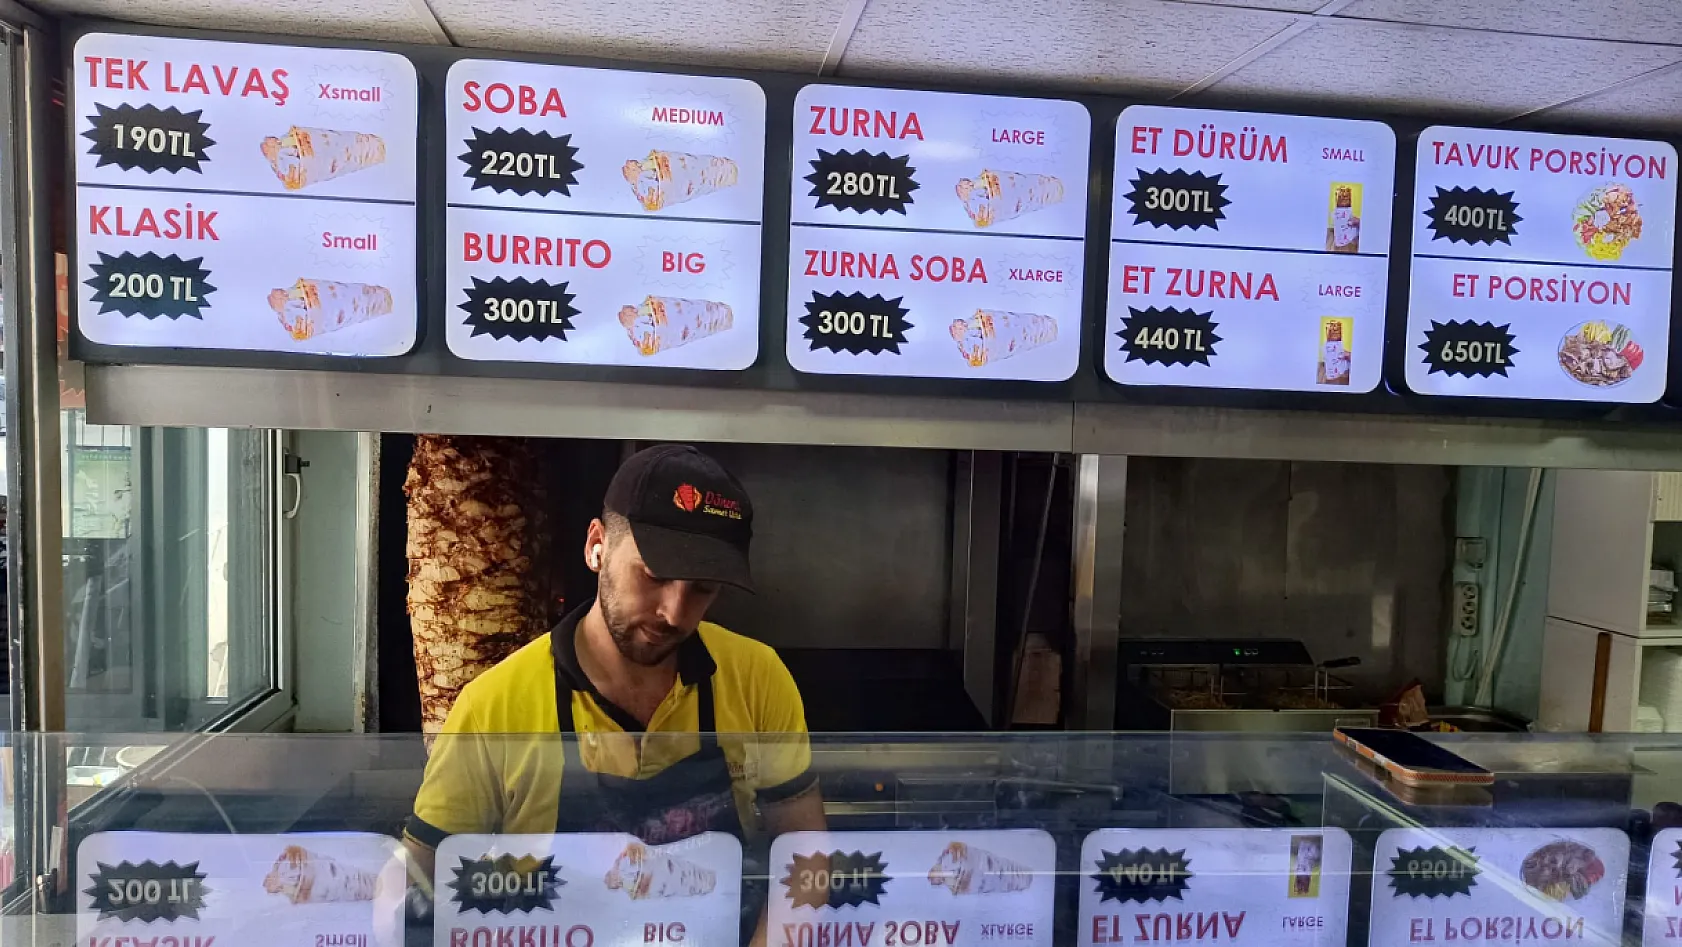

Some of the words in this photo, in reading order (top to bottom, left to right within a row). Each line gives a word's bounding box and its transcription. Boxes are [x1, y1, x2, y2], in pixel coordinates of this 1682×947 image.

[85, 55, 149, 92] TEK
[164, 61, 290, 108] LAVAŞ
[319, 83, 382, 104] Xsmall
[463, 80, 567, 119] SOBA
[652, 106, 725, 127] MEDIUM
[809, 105, 925, 141] ZURNA
[112, 123, 196, 158] 190TL
[991, 128, 1045, 147] LARGE
[1131, 125, 1163, 155] ET
[1173, 123, 1288, 163] DÜRÜM
[480, 150, 561, 179] 220TL
[1321, 146, 1364, 163] SMALL
[1432, 140, 1520, 170] TAVUK
[1529, 144, 1668, 180] PORSİYON
[826, 171, 900, 199] 280TL
[1144, 186, 1214, 212] 300TL
[90, 201, 220, 242] KLASİK
[1444, 205, 1507, 231] 400TL
[321, 231, 379, 252] Small
[463, 231, 613, 270] BURRITO
[662, 251, 707, 275] BIG
[804, 249, 900, 281] ZURNA
[909, 254, 988, 284] SOBA
[1009, 268, 1064, 284] XLARGE
[108, 272, 164, 298] 200
[169, 276, 198, 302] TL
[1122, 264, 1156, 295] ET
[1165, 267, 1279, 301] ZURNA
[1318, 284, 1362, 298] LARGE
[1451, 273, 1481, 298] ET
[1488, 271, 1632, 306] PORSİYON
[483, 297, 562, 324] 300TL
[817, 310, 866, 335] 300
[869, 314, 893, 339] TL
[1134, 326, 1179, 350] 440
[1183, 328, 1205, 352] TL
[1441, 340, 1505, 364] 650TL
